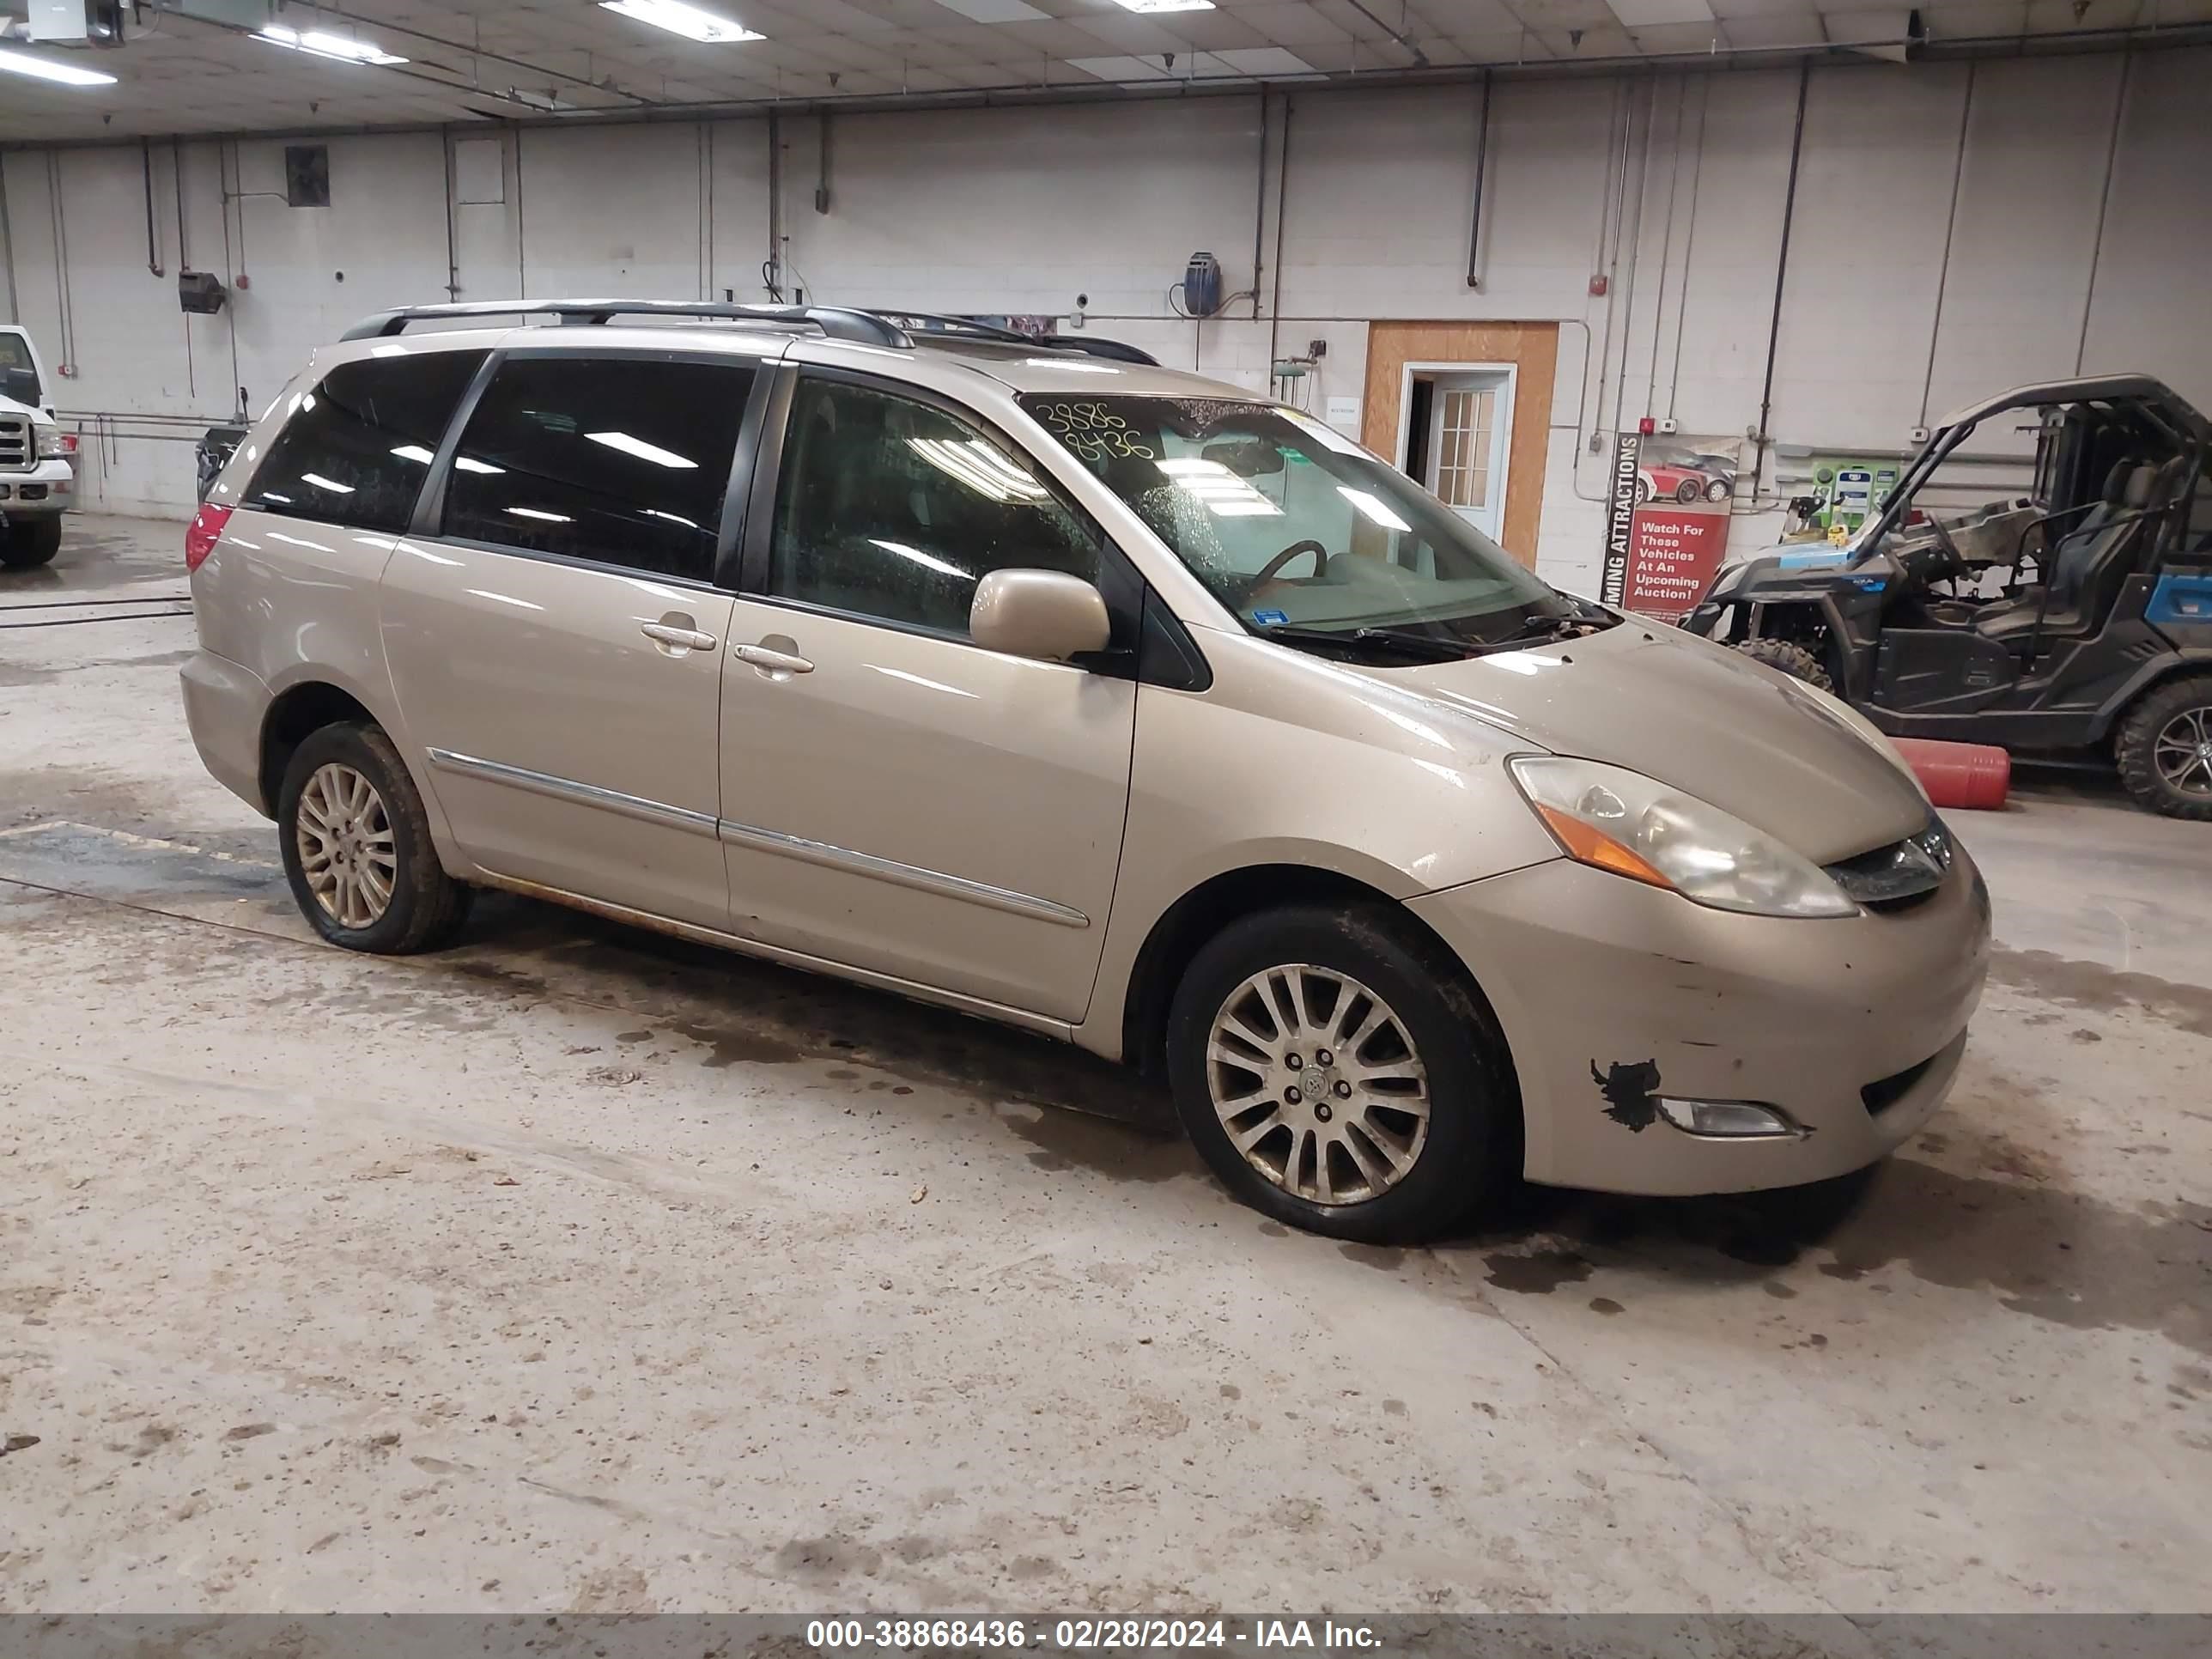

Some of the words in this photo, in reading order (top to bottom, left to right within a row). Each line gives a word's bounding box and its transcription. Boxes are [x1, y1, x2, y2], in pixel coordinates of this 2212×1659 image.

[1036, 402, 1126, 433] 3886
[1065, 430, 1154, 460] 8436
[1611, 437, 1638, 554] ATTRACTIONS
[1642, 521, 1680, 534] Watch
[1683, 525, 1705, 536] For
[1640, 535, 1680, 547] These
[1638, 548, 1695, 562] Vehicles
[1637, 561, 1654, 571] At
[1656, 562, 1675, 573] An
[1636, 573, 1700, 590] Upcoming
[1634, 586, 1692, 600] Auction!
